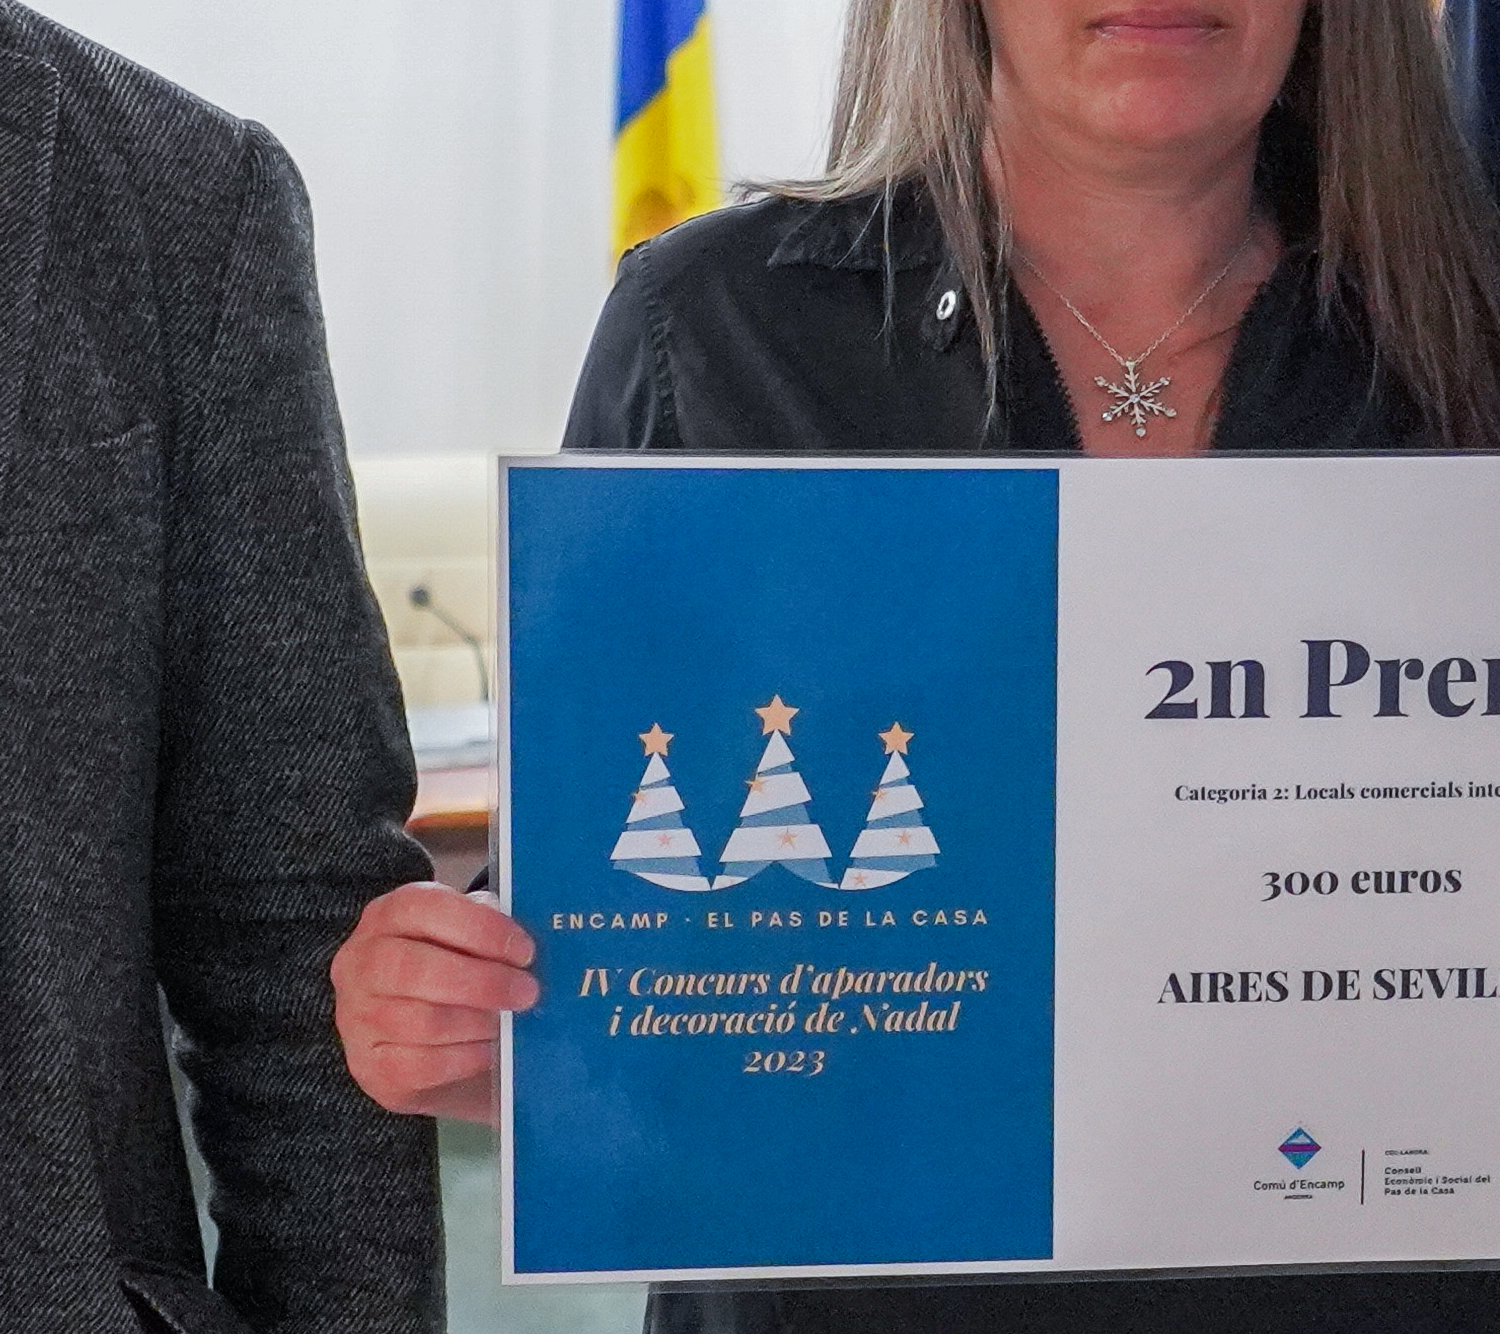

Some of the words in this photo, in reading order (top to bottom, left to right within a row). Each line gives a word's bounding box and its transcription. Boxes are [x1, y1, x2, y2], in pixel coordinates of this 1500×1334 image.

[1144, 659, 1270, 719] 2n
[1174, 784, 1267, 803] Categoria
[1273, 788, 1289, 800] 2:
[1295, 783, 1355, 800] Locals
[1360, 781, 1463, 799] comercials
[1262, 871, 1339, 902] 300
[1351, 869, 1462, 894] euros
[553, 913, 667, 929] ENCAMP
[708, 913, 733, 927] EL
[752, 912, 801, 926] PAS
[820, 912, 847, 926] DE
[866, 911, 895, 926] LA
[913, 910, 986, 925] CASA
[581, 969, 623, 996] IV
[629, 969, 770, 995] Concurs
[780, 963, 988, 999] d'aparadors
[1157, 970, 1289, 1004] AIRES
[1301, 970, 1360, 1001] DE
[610, 1006, 622, 1035] i
[631, 1001, 796, 1035] decoració
[805, 1003, 844, 1032] de
[851, 1001, 960, 1033] Nadal
[744, 1051, 824, 1074] 2023
[1288, 1178, 1346, 1191] d'Encamp
[1383, 1187, 1402, 1196] Pas
[1403, 1187, 1417, 1196] de
[1419, 1187, 1429, 1195] la
[1430, 1186, 1455, 1195] Casa
[1441, 1175, 1473, 1185] Social
[1474, 1174, 1491, 1184] del
